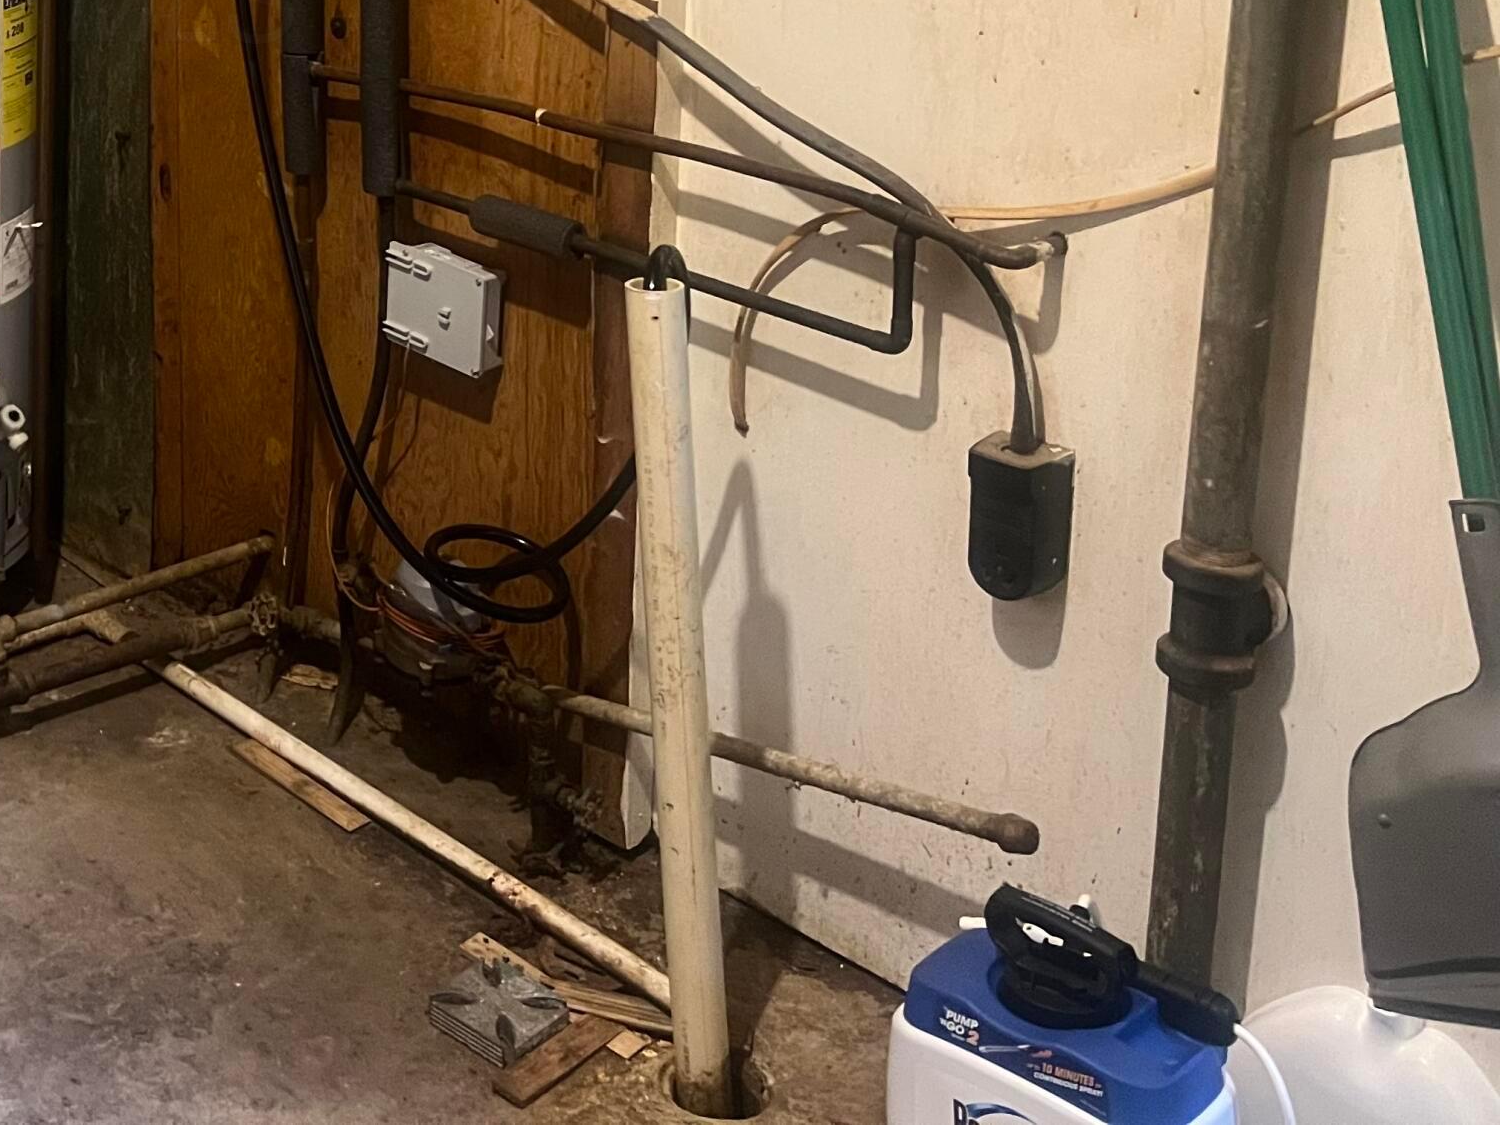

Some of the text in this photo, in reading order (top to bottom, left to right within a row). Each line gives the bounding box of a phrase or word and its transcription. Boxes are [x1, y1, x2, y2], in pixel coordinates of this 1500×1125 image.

[946, 1009, 979, 1029] PUMP
[966, 1029, 980, 1046] 2
[1054, 1065, 1096, 1087] MINUTES
